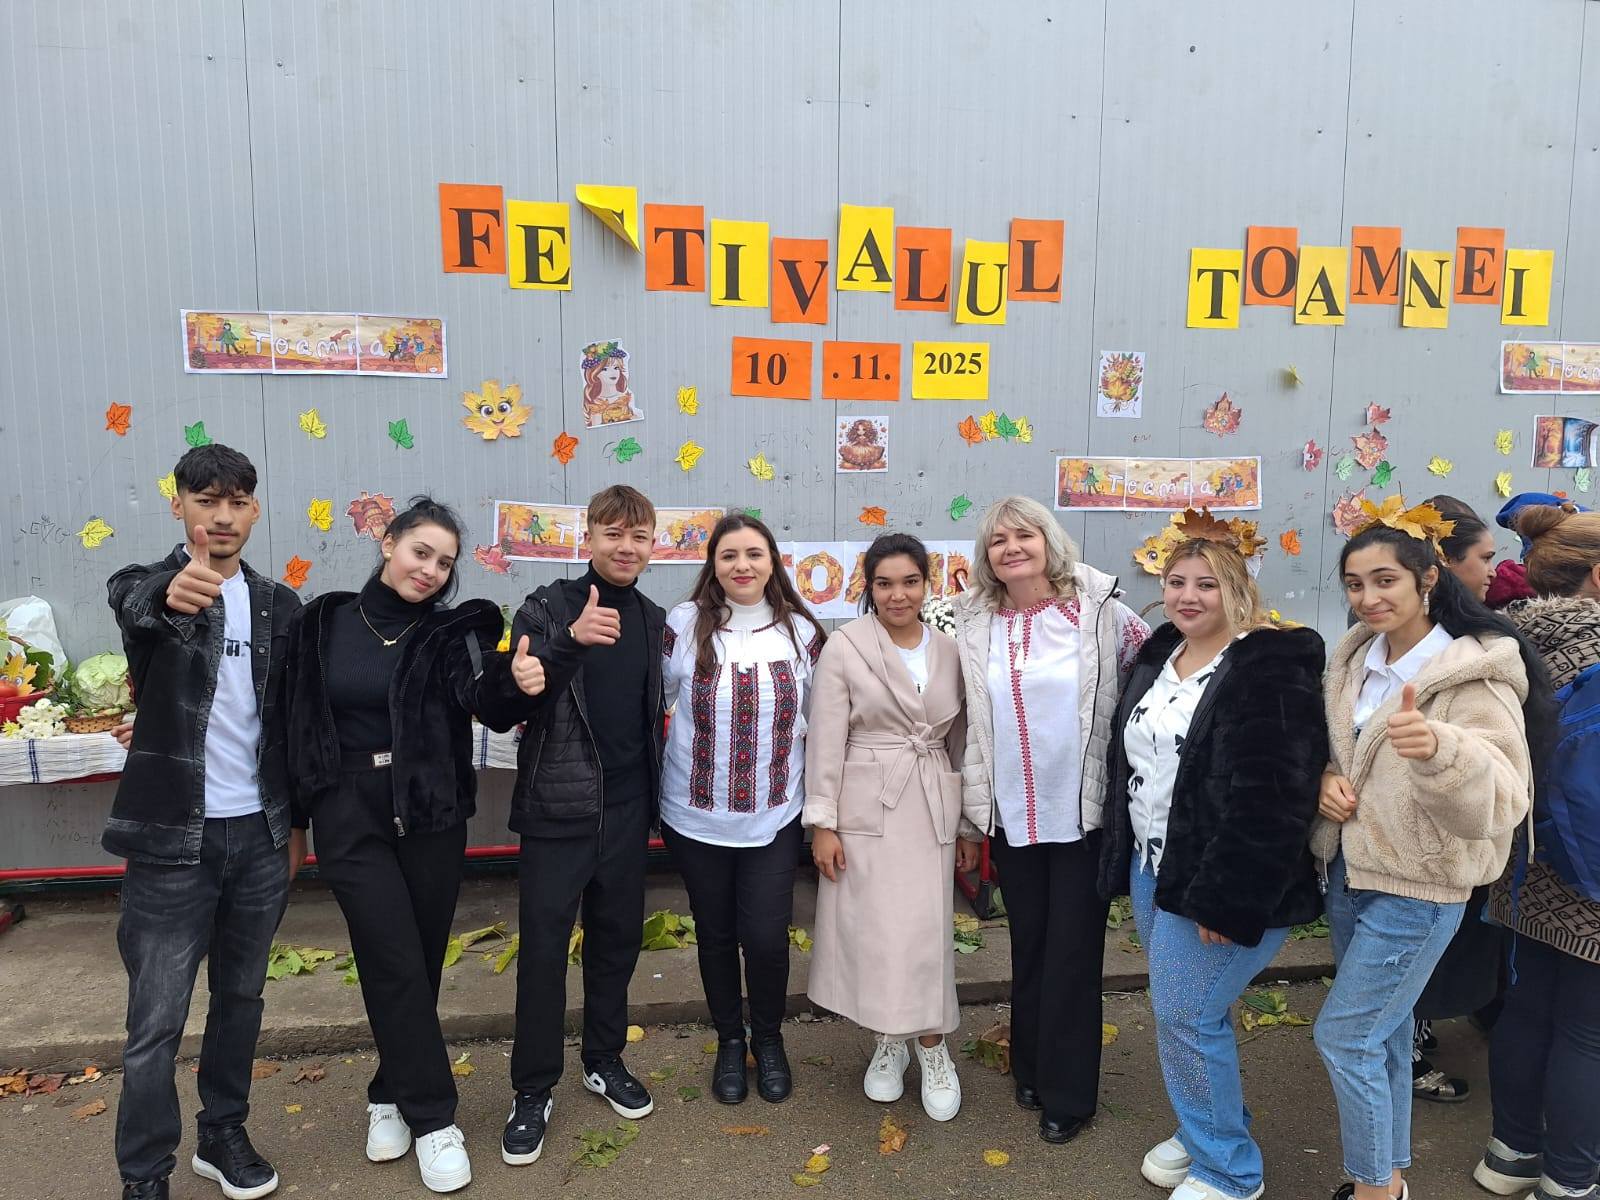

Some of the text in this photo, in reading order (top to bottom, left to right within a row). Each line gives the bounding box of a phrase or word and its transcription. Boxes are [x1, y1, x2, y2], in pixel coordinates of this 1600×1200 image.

[448, 206, 1531, 320] FETIVALUL TOAMNEI
[249, 328, 387, 358] Toamna
[745, 351, 788, 386] 10
[923, 351, 983, 376] 2025
[1107, 473, 1214, 497] Toamna
